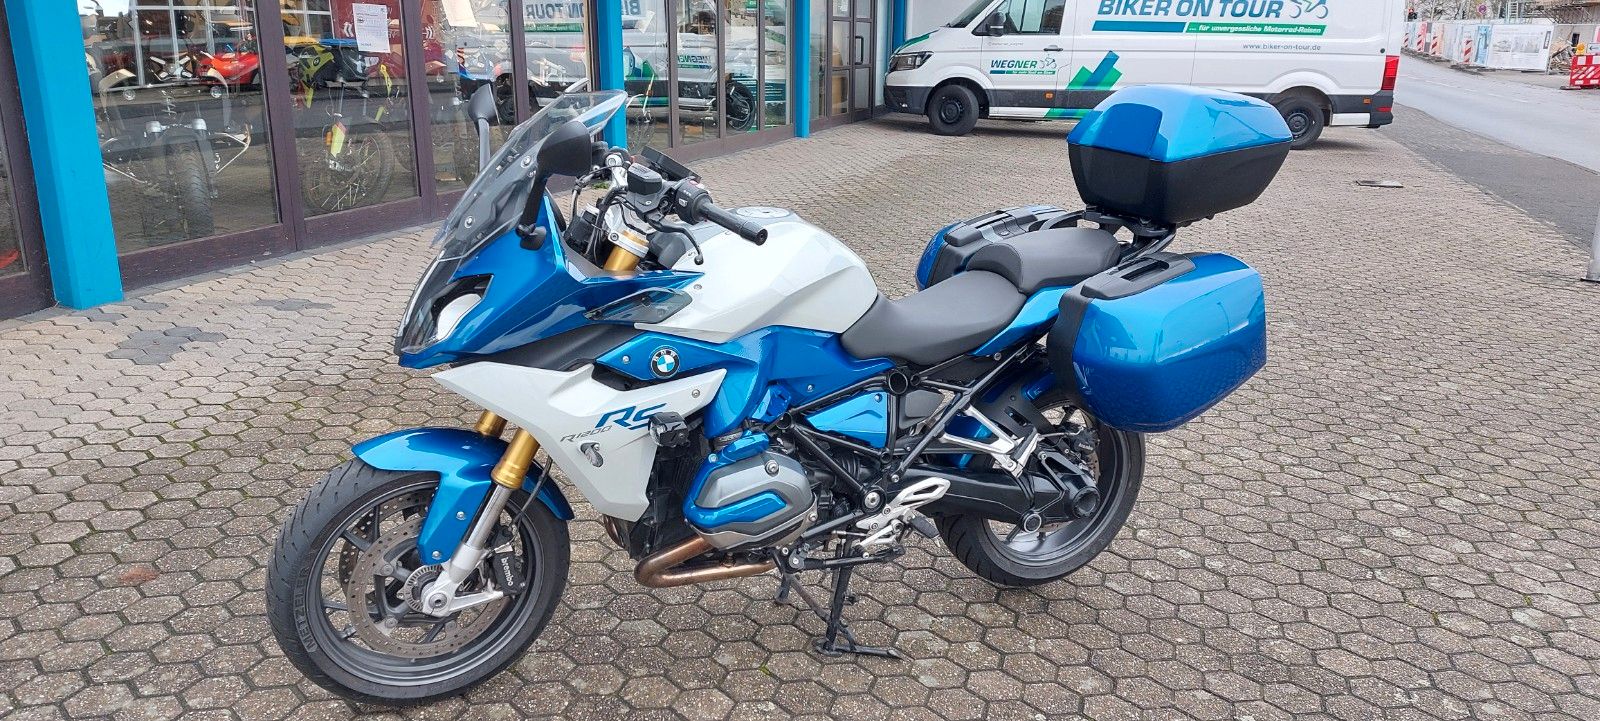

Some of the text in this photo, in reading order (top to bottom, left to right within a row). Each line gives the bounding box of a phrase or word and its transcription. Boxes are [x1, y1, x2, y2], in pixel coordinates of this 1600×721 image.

[1097, 0, 1284, 18] BIKER ON TOUR
[1211, 25, 1262, 33] unvergessliche
[1263, 25, 1322, 34] Motorrad-Reisen
[1242, 42, 1321, 51] www.biker-on-tour.de
[990, 59, 1038, 69] WEGNER
[595, 402, 667, 430] RS
[560, 425, 613, 442] R1200
[501, 556, 514, 587] brembo
